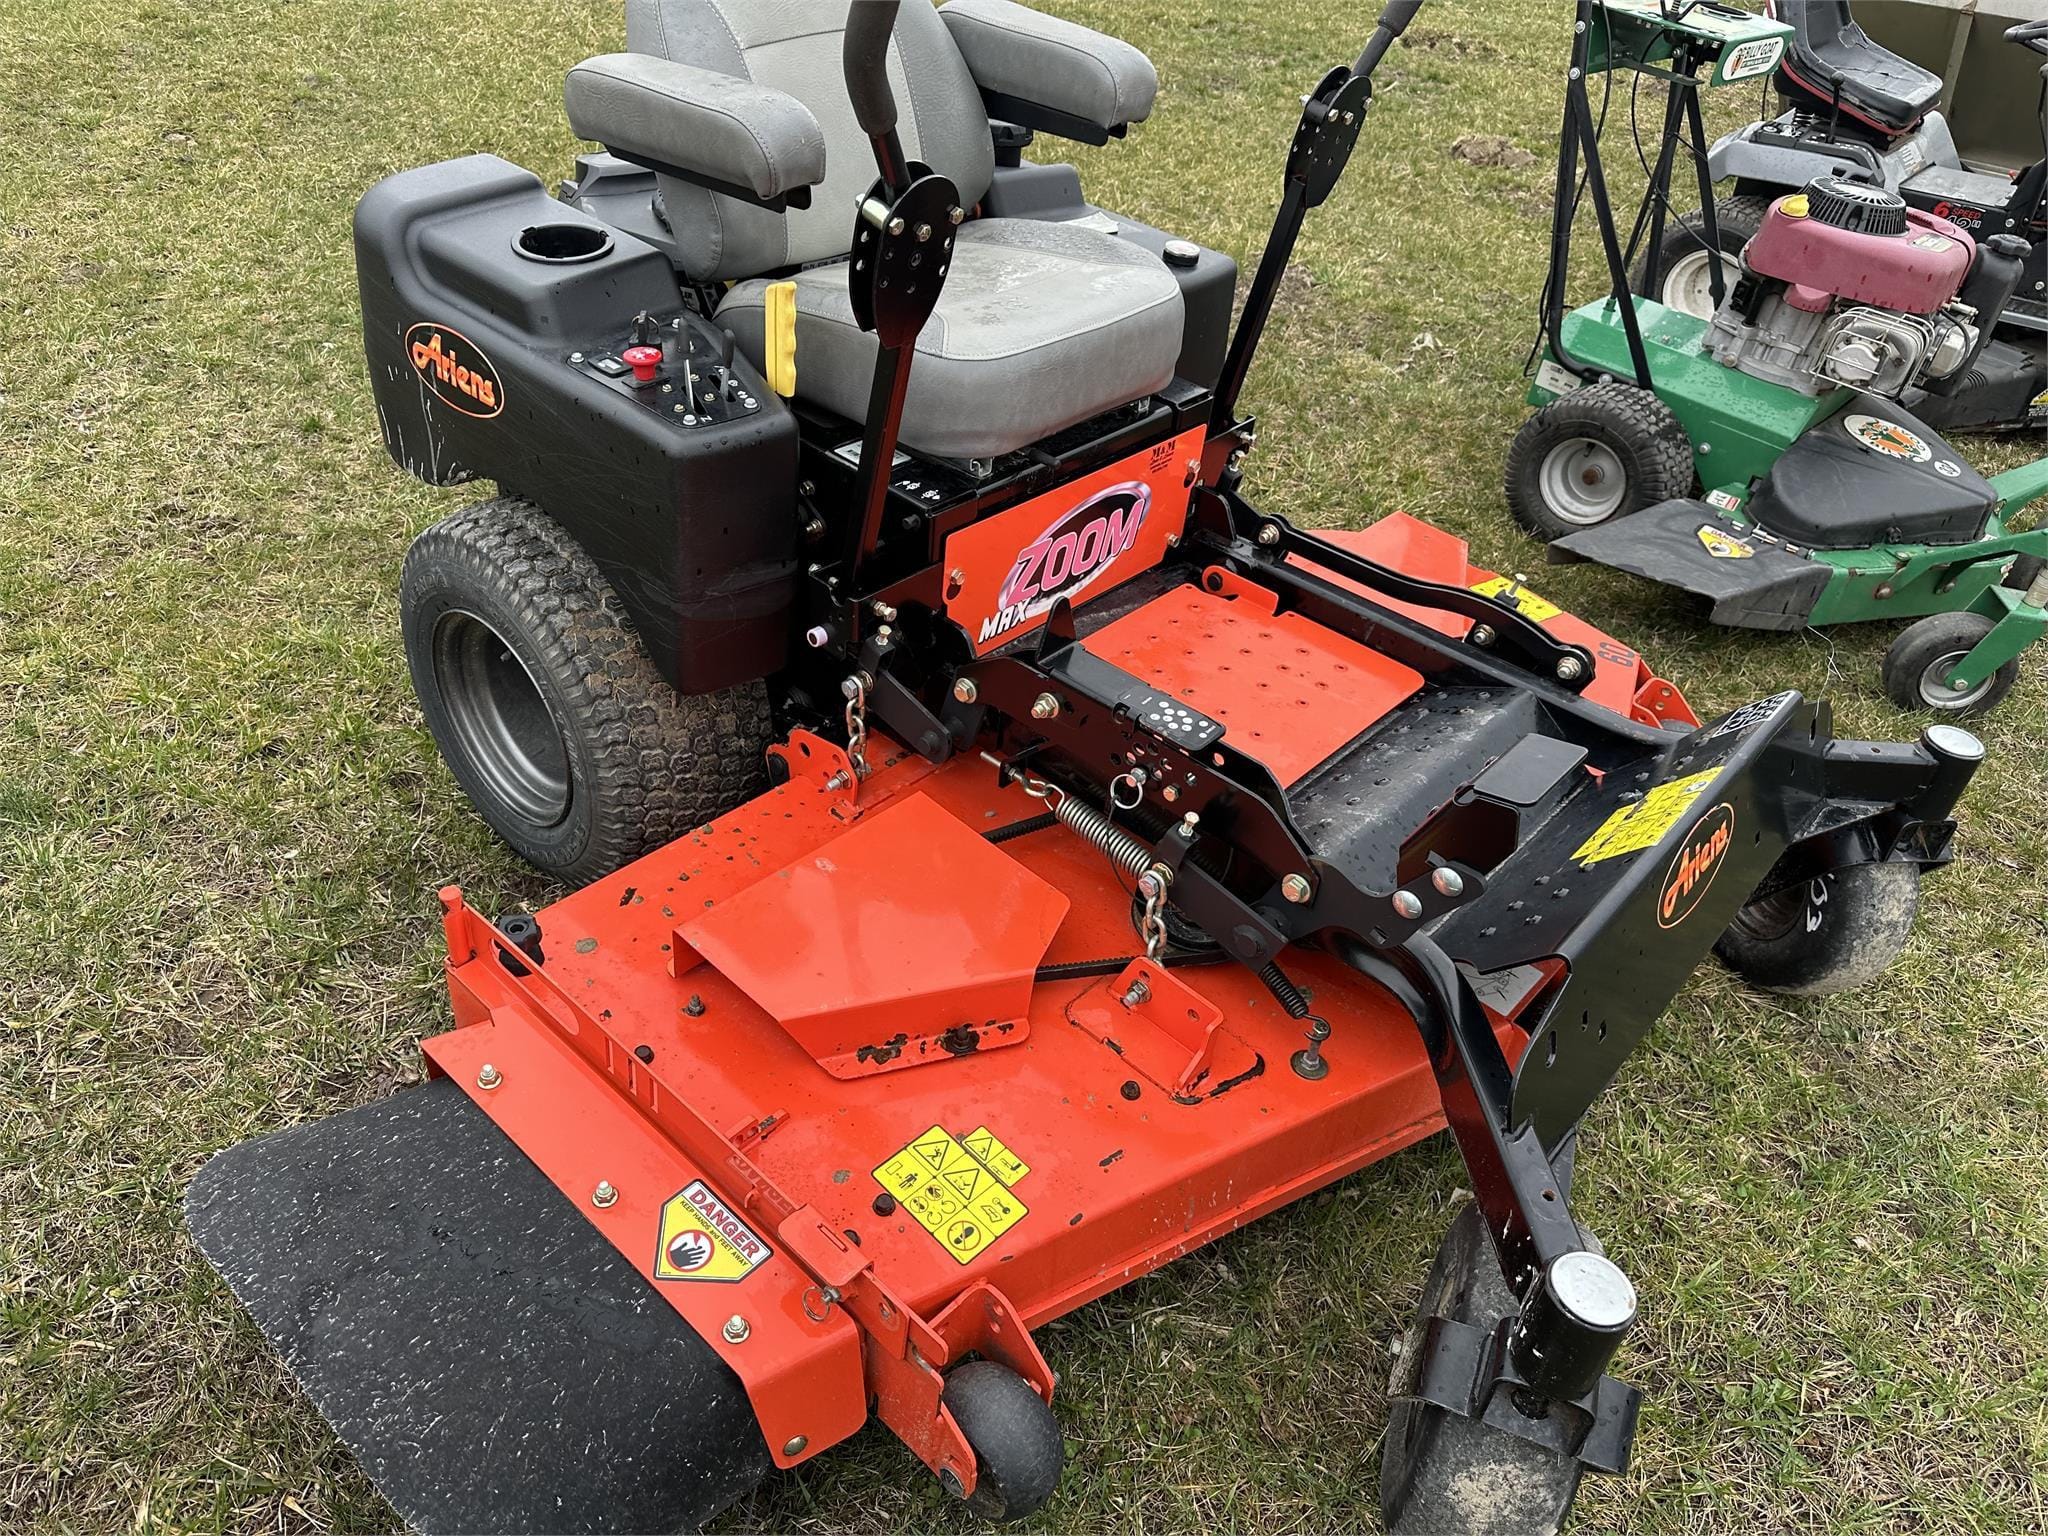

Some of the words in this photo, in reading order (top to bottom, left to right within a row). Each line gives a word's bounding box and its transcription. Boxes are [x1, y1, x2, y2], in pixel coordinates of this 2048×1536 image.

[1933, 201, 1952, 218] 6
[1951, 207, 1982, 219] SPEED
[412, 333, 496, 408] Ariens
[1004, 498, 1146, 604] ZOOM
[977, 597, 1031, 644] MAX
[1598, 642, 1635, 667] 60
[1663, 820, 1729, 918] Ariens
[680, 1200, 696, 1214] KEEP
[692, 1211, 711, 1231] HANDS
[709, 1229, 721, 1241] and
[718, 1237, 735, 1252] FEET
[731, 1250, 749, 1267] AWAY
[689, 1189, 760, 1259] DANGER
